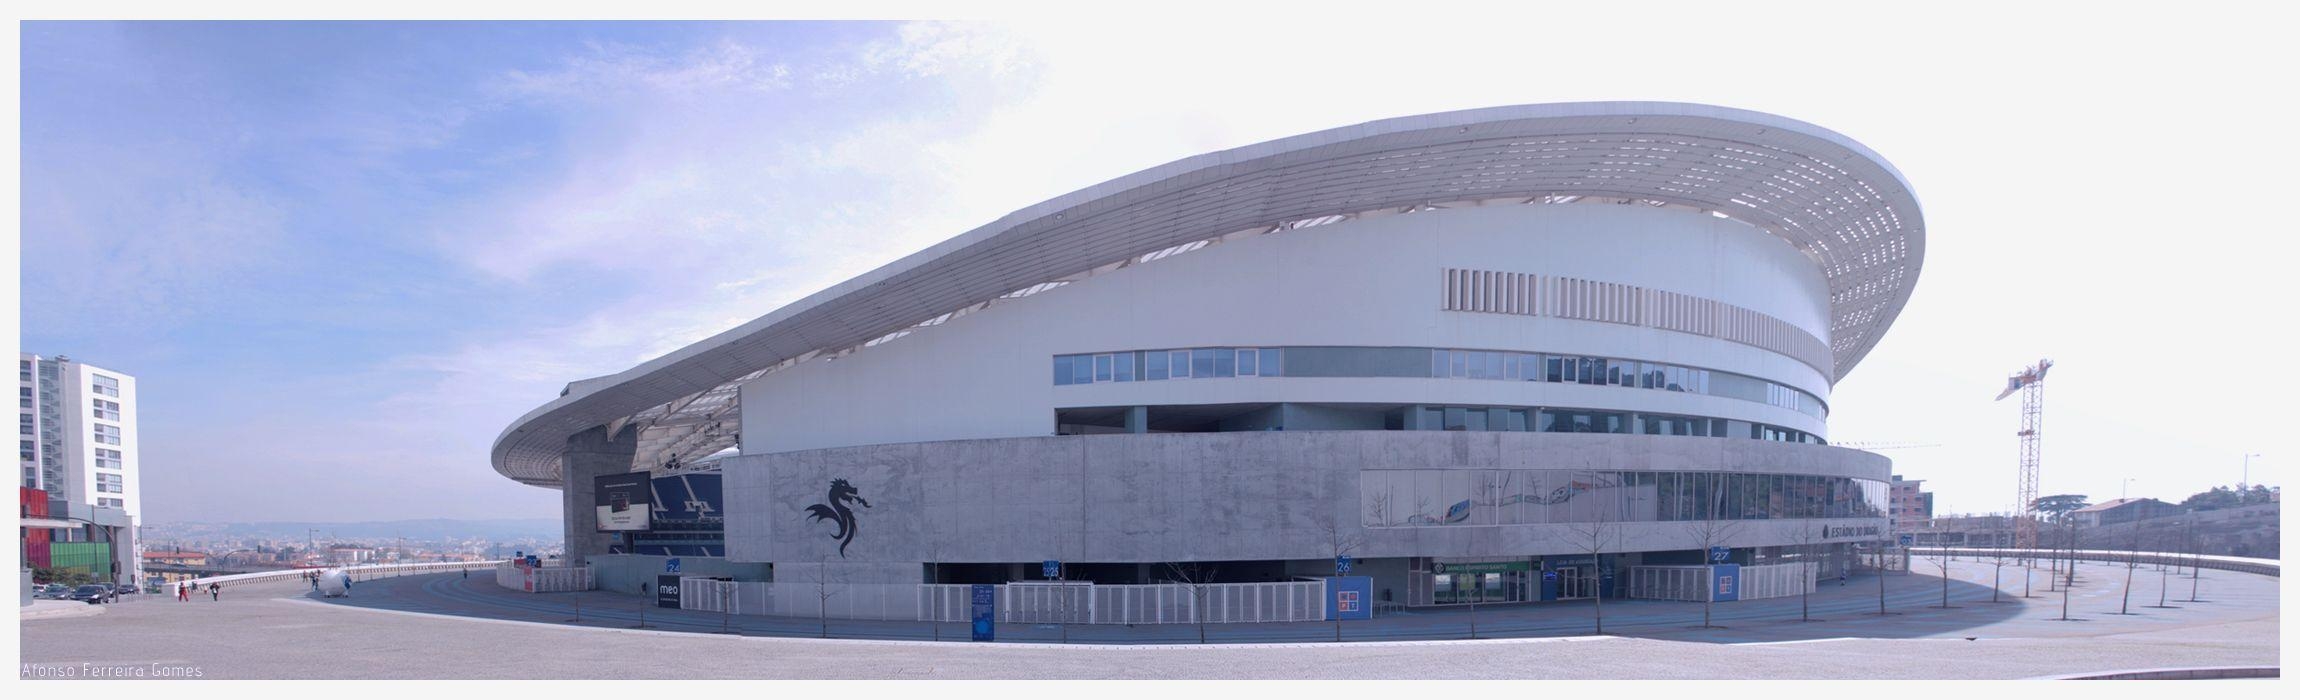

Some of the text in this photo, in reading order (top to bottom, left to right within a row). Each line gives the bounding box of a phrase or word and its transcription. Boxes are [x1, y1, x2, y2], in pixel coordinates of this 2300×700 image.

[1714, 551, 1729, 561] 27
[669, 564, 680, 572] 24
[1337, 562, 1350, 572] 26
[660, 585, 678, 595] meo
